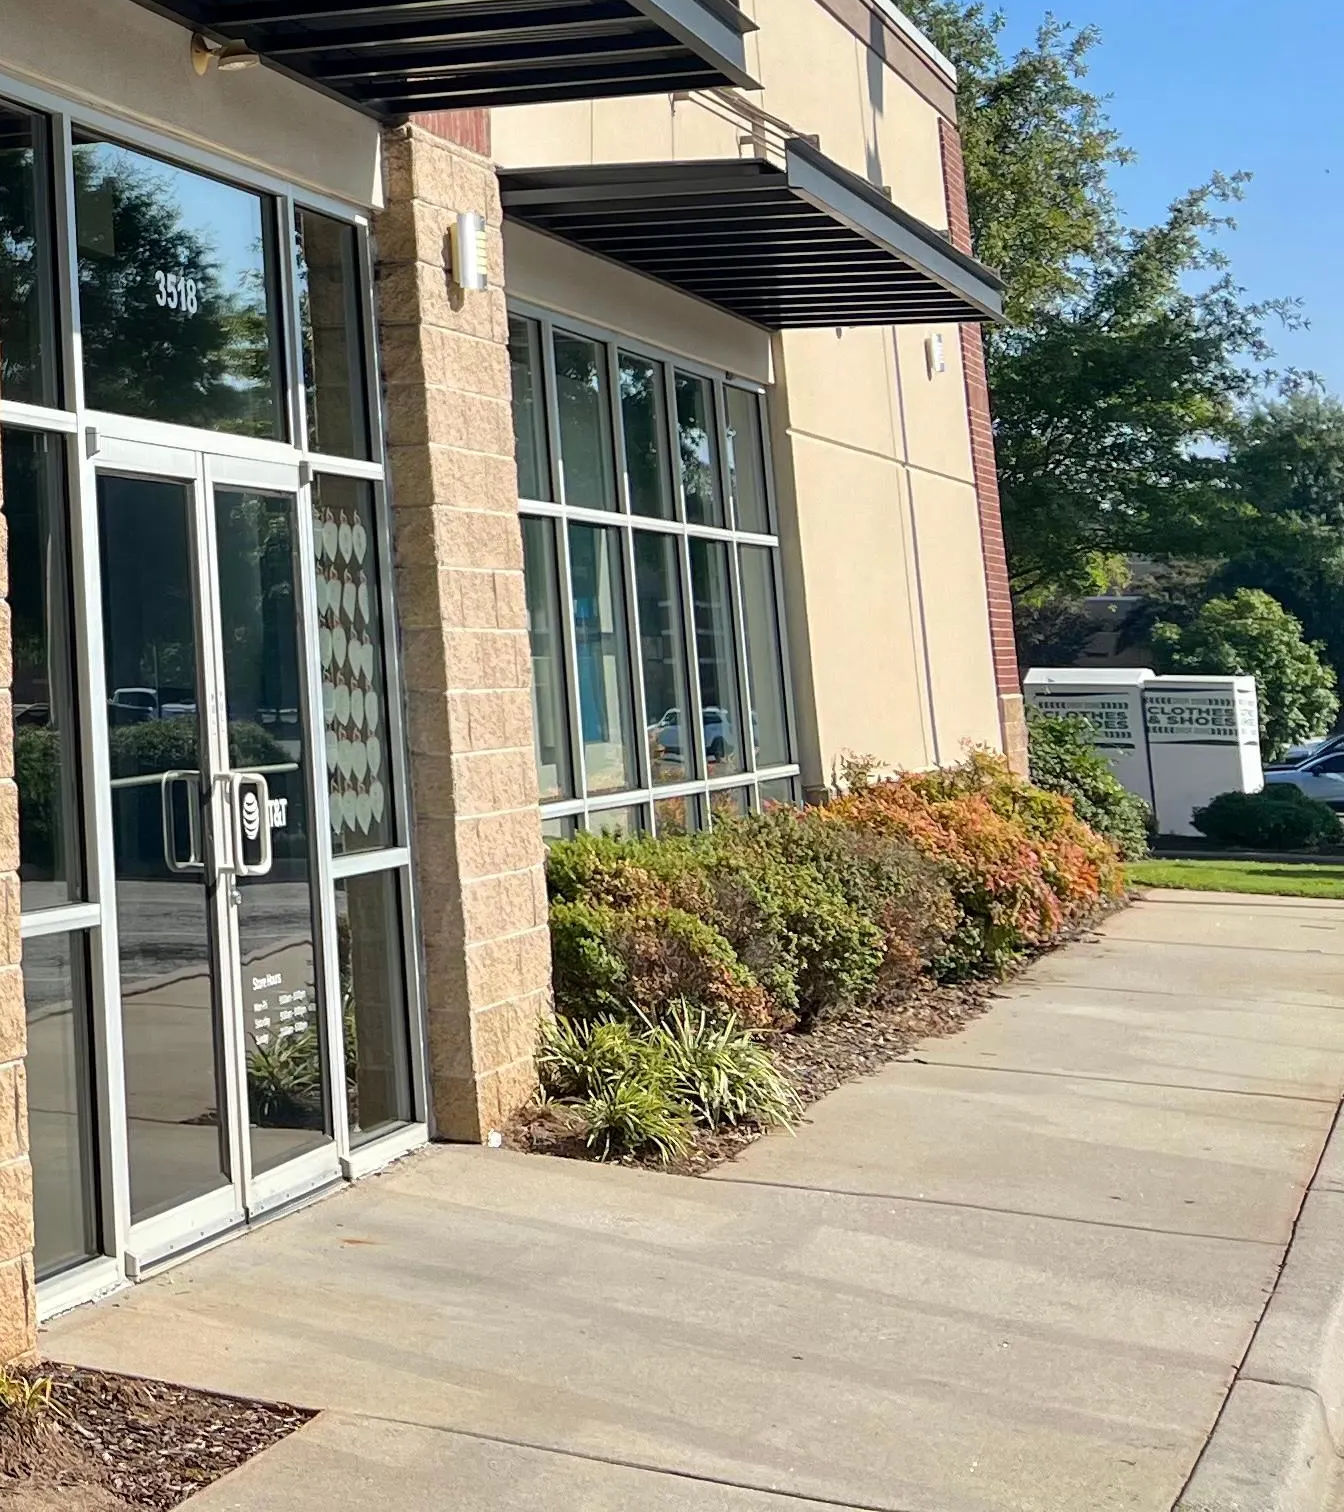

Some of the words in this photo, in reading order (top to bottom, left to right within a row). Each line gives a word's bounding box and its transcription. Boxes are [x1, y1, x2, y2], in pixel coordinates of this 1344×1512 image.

[154, 270, 198, 314] 3518
[1148, 706, 1234, 718] CLOTHES
[1148, 716, 1161, 725] &
[1167, 716, 1237, 727] SHOES
[266, 798, 288, 828] T&T
